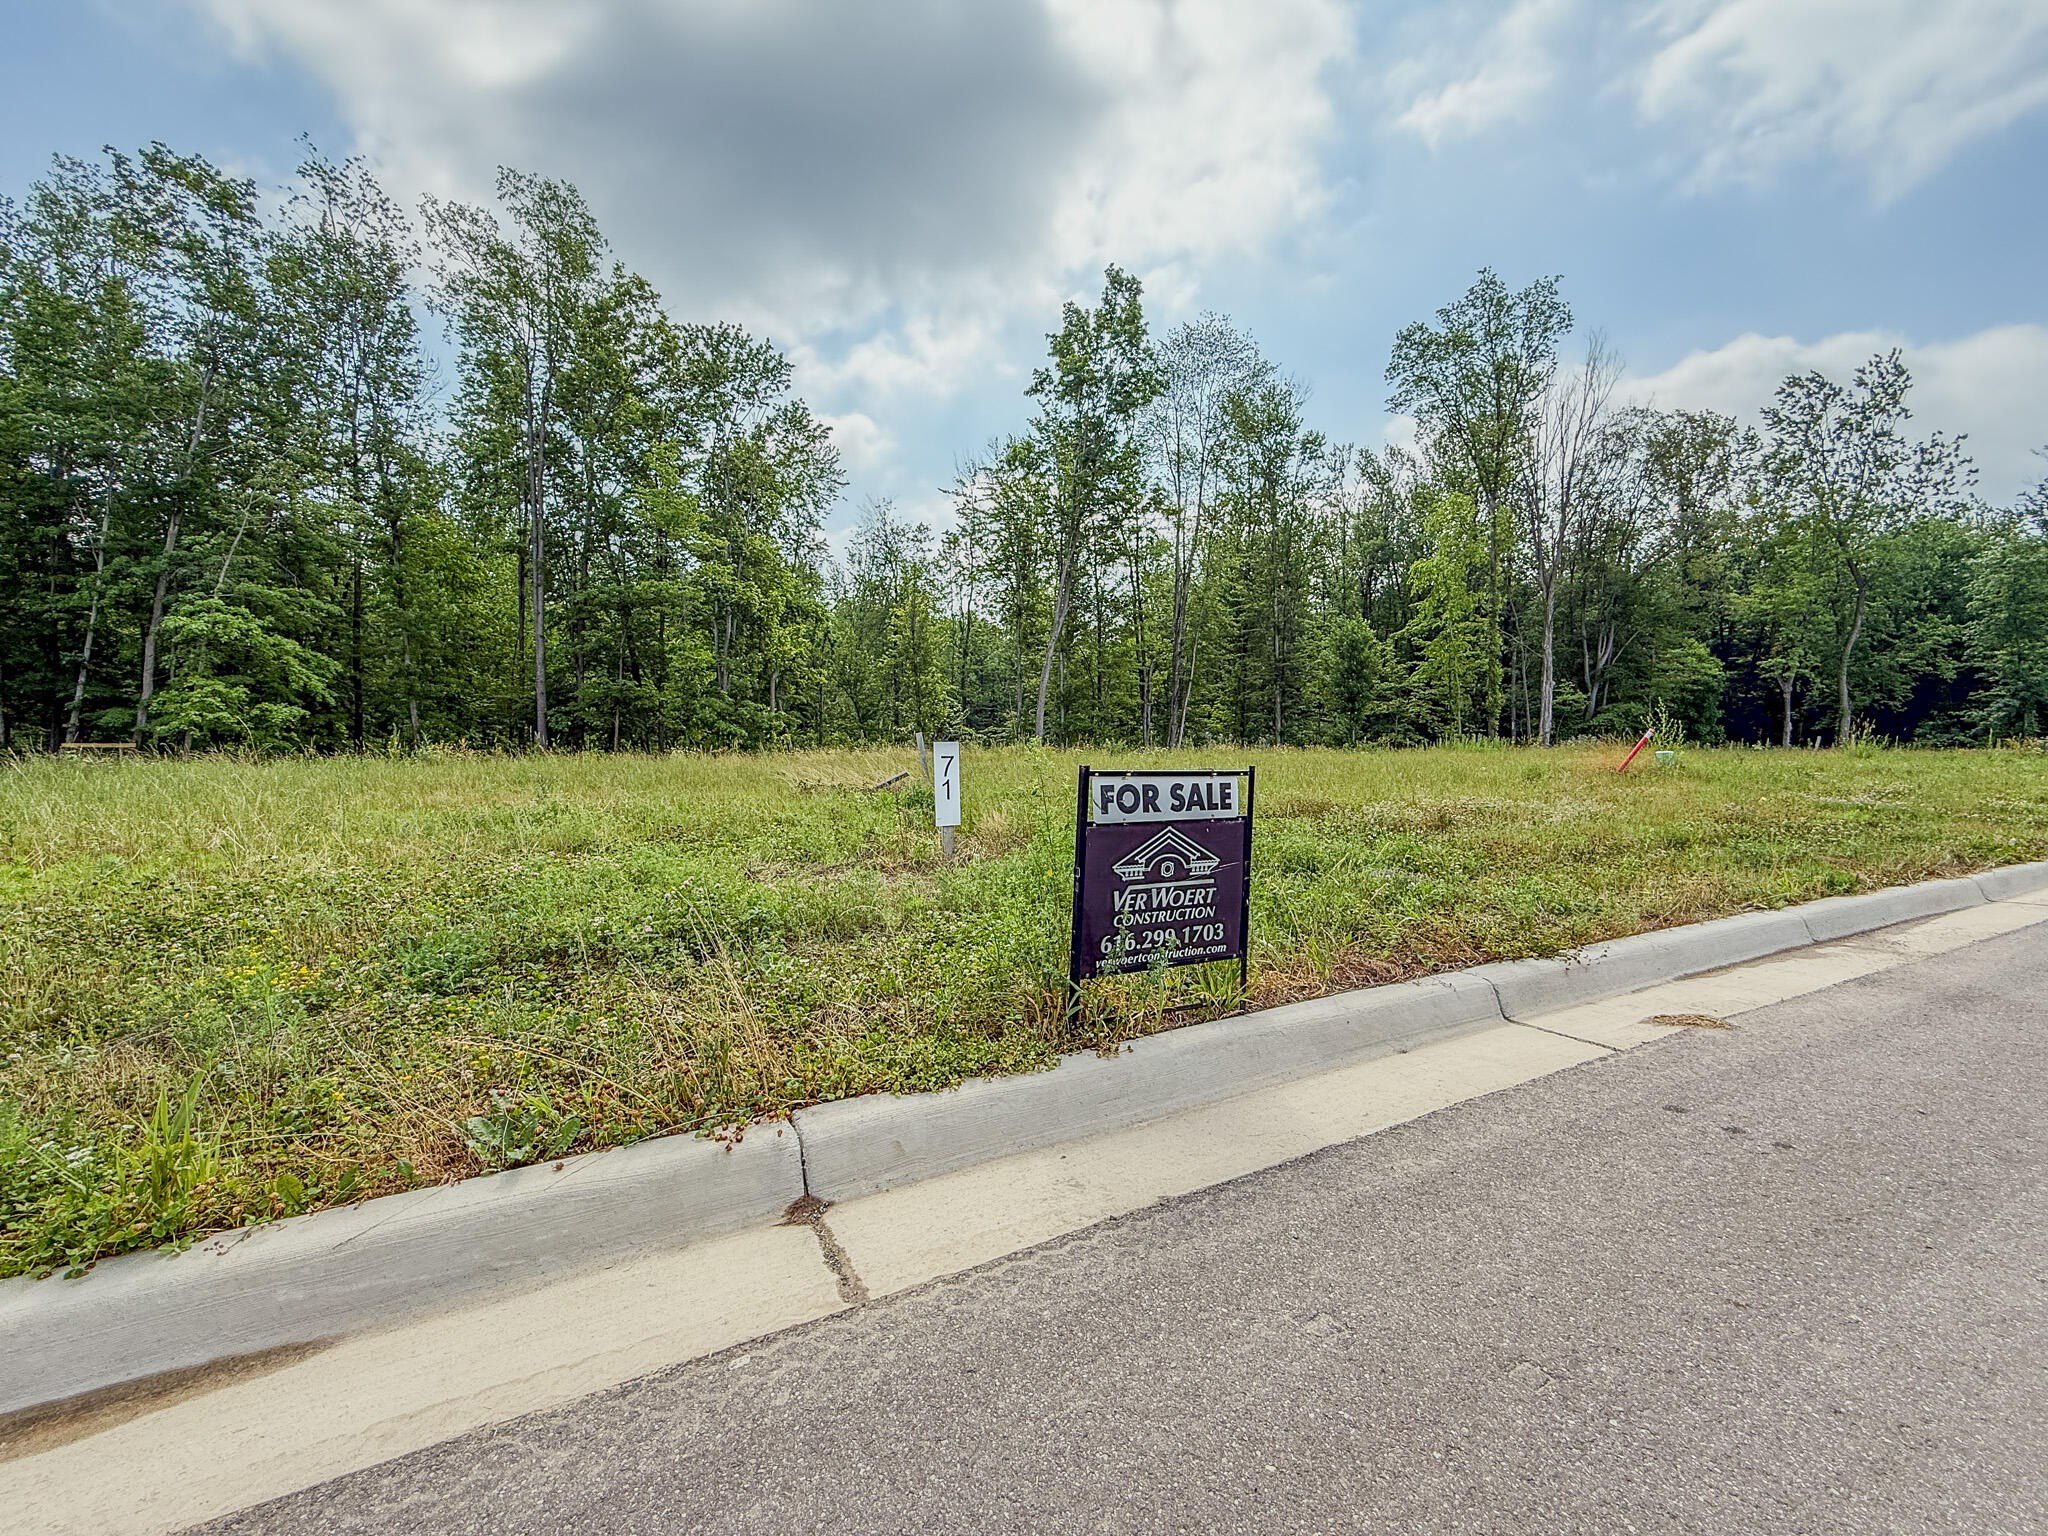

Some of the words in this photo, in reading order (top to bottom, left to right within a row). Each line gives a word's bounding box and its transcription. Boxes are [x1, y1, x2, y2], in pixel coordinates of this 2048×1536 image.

[941, 756, 954, 800] 71
[1100, 783, 1161, 814] FOR
[1170, 782, 1232, 812] SALE
[1113, 888, 1148, 911] VER
[1151, 887, 1217, 908] WOERT
[1113, 906, 1216, 927] CONSTRUCTION
